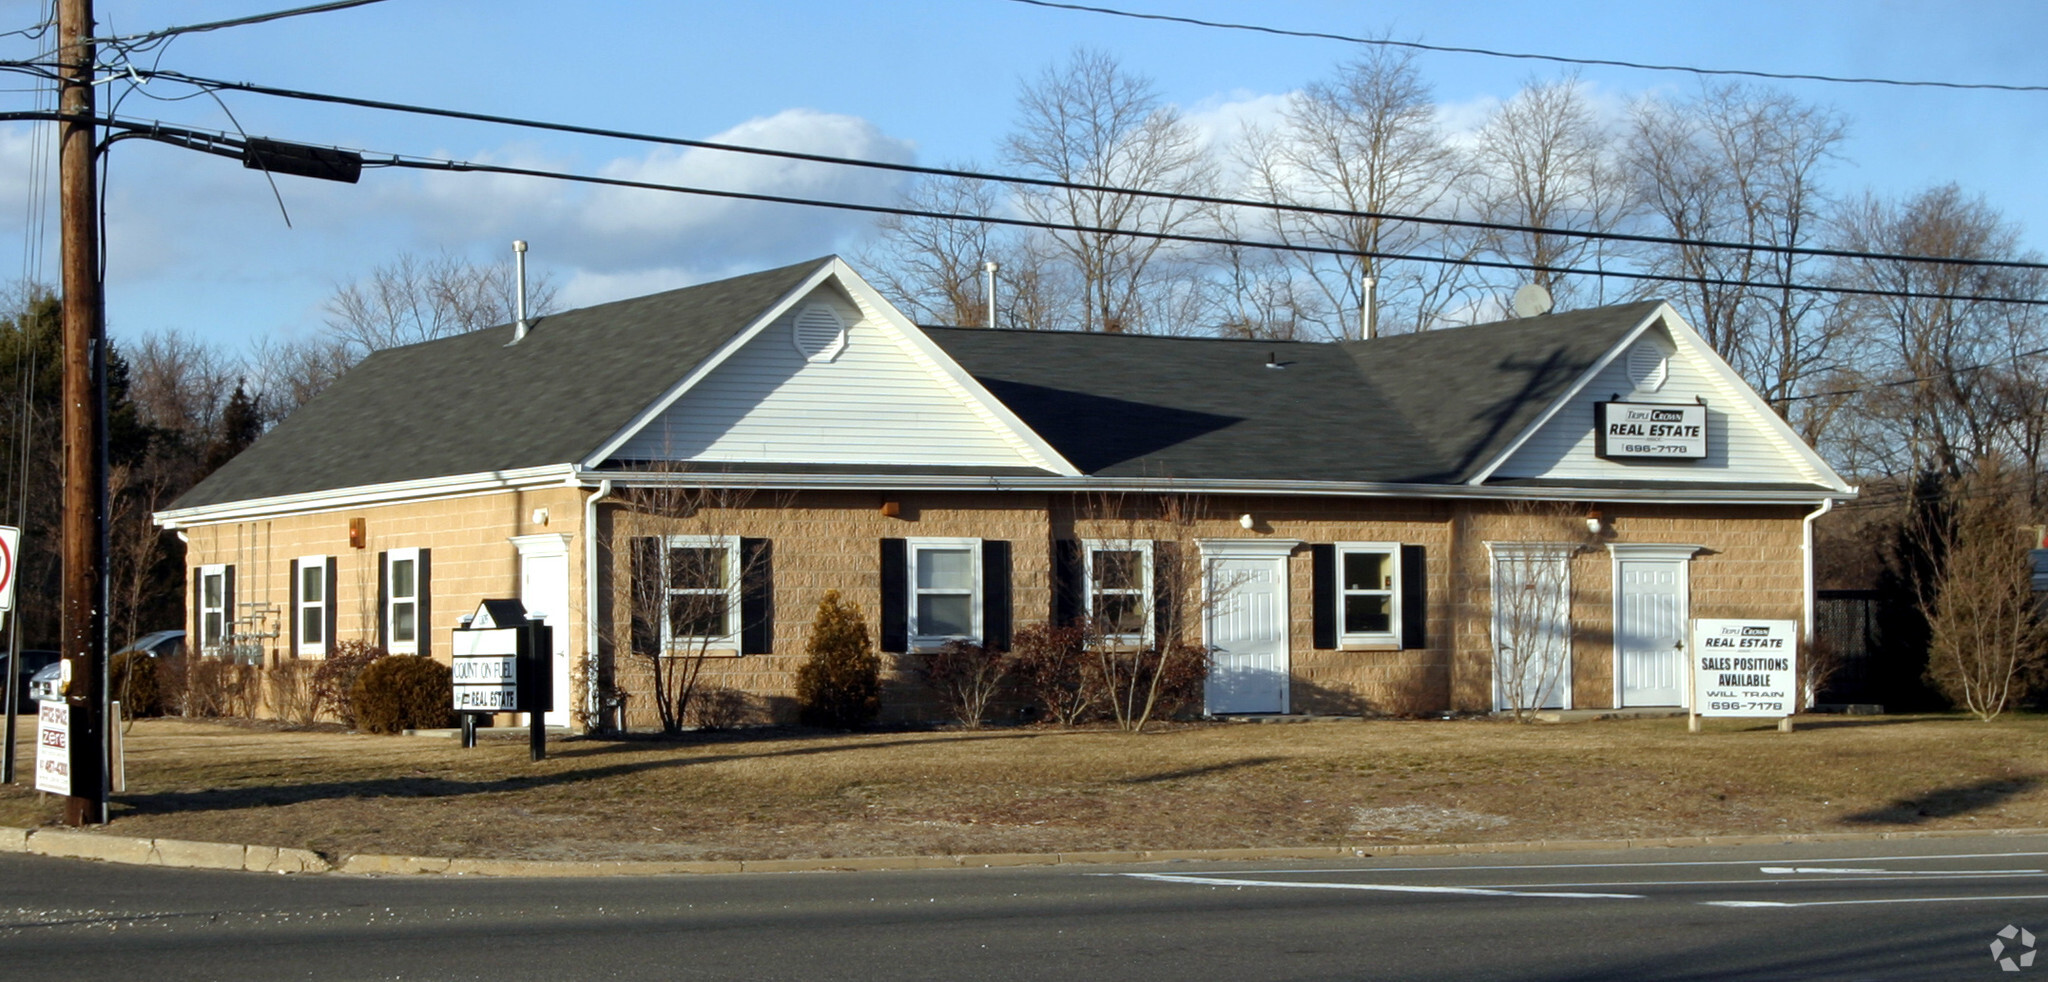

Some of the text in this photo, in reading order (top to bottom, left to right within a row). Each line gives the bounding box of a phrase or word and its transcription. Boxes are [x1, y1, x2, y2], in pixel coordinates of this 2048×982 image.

[1609, 424, 1700, 437] REAL ESTATE
[1625, 444, 1687, 453] 696-7178
[1705, 638, 1784, 648] REAL ESTATE
[454, 662, 512, 679] COUNT ON FUEL
[1701, 657, 1789, 671] SALES POSITIONS
[1718, 674, 1771, 687] AVAILABLE
[471, 691, 487, 706] REAL
[490, 691, 514, 707] ESTATE
[1711, 701, 1783, 710] 696-7178
